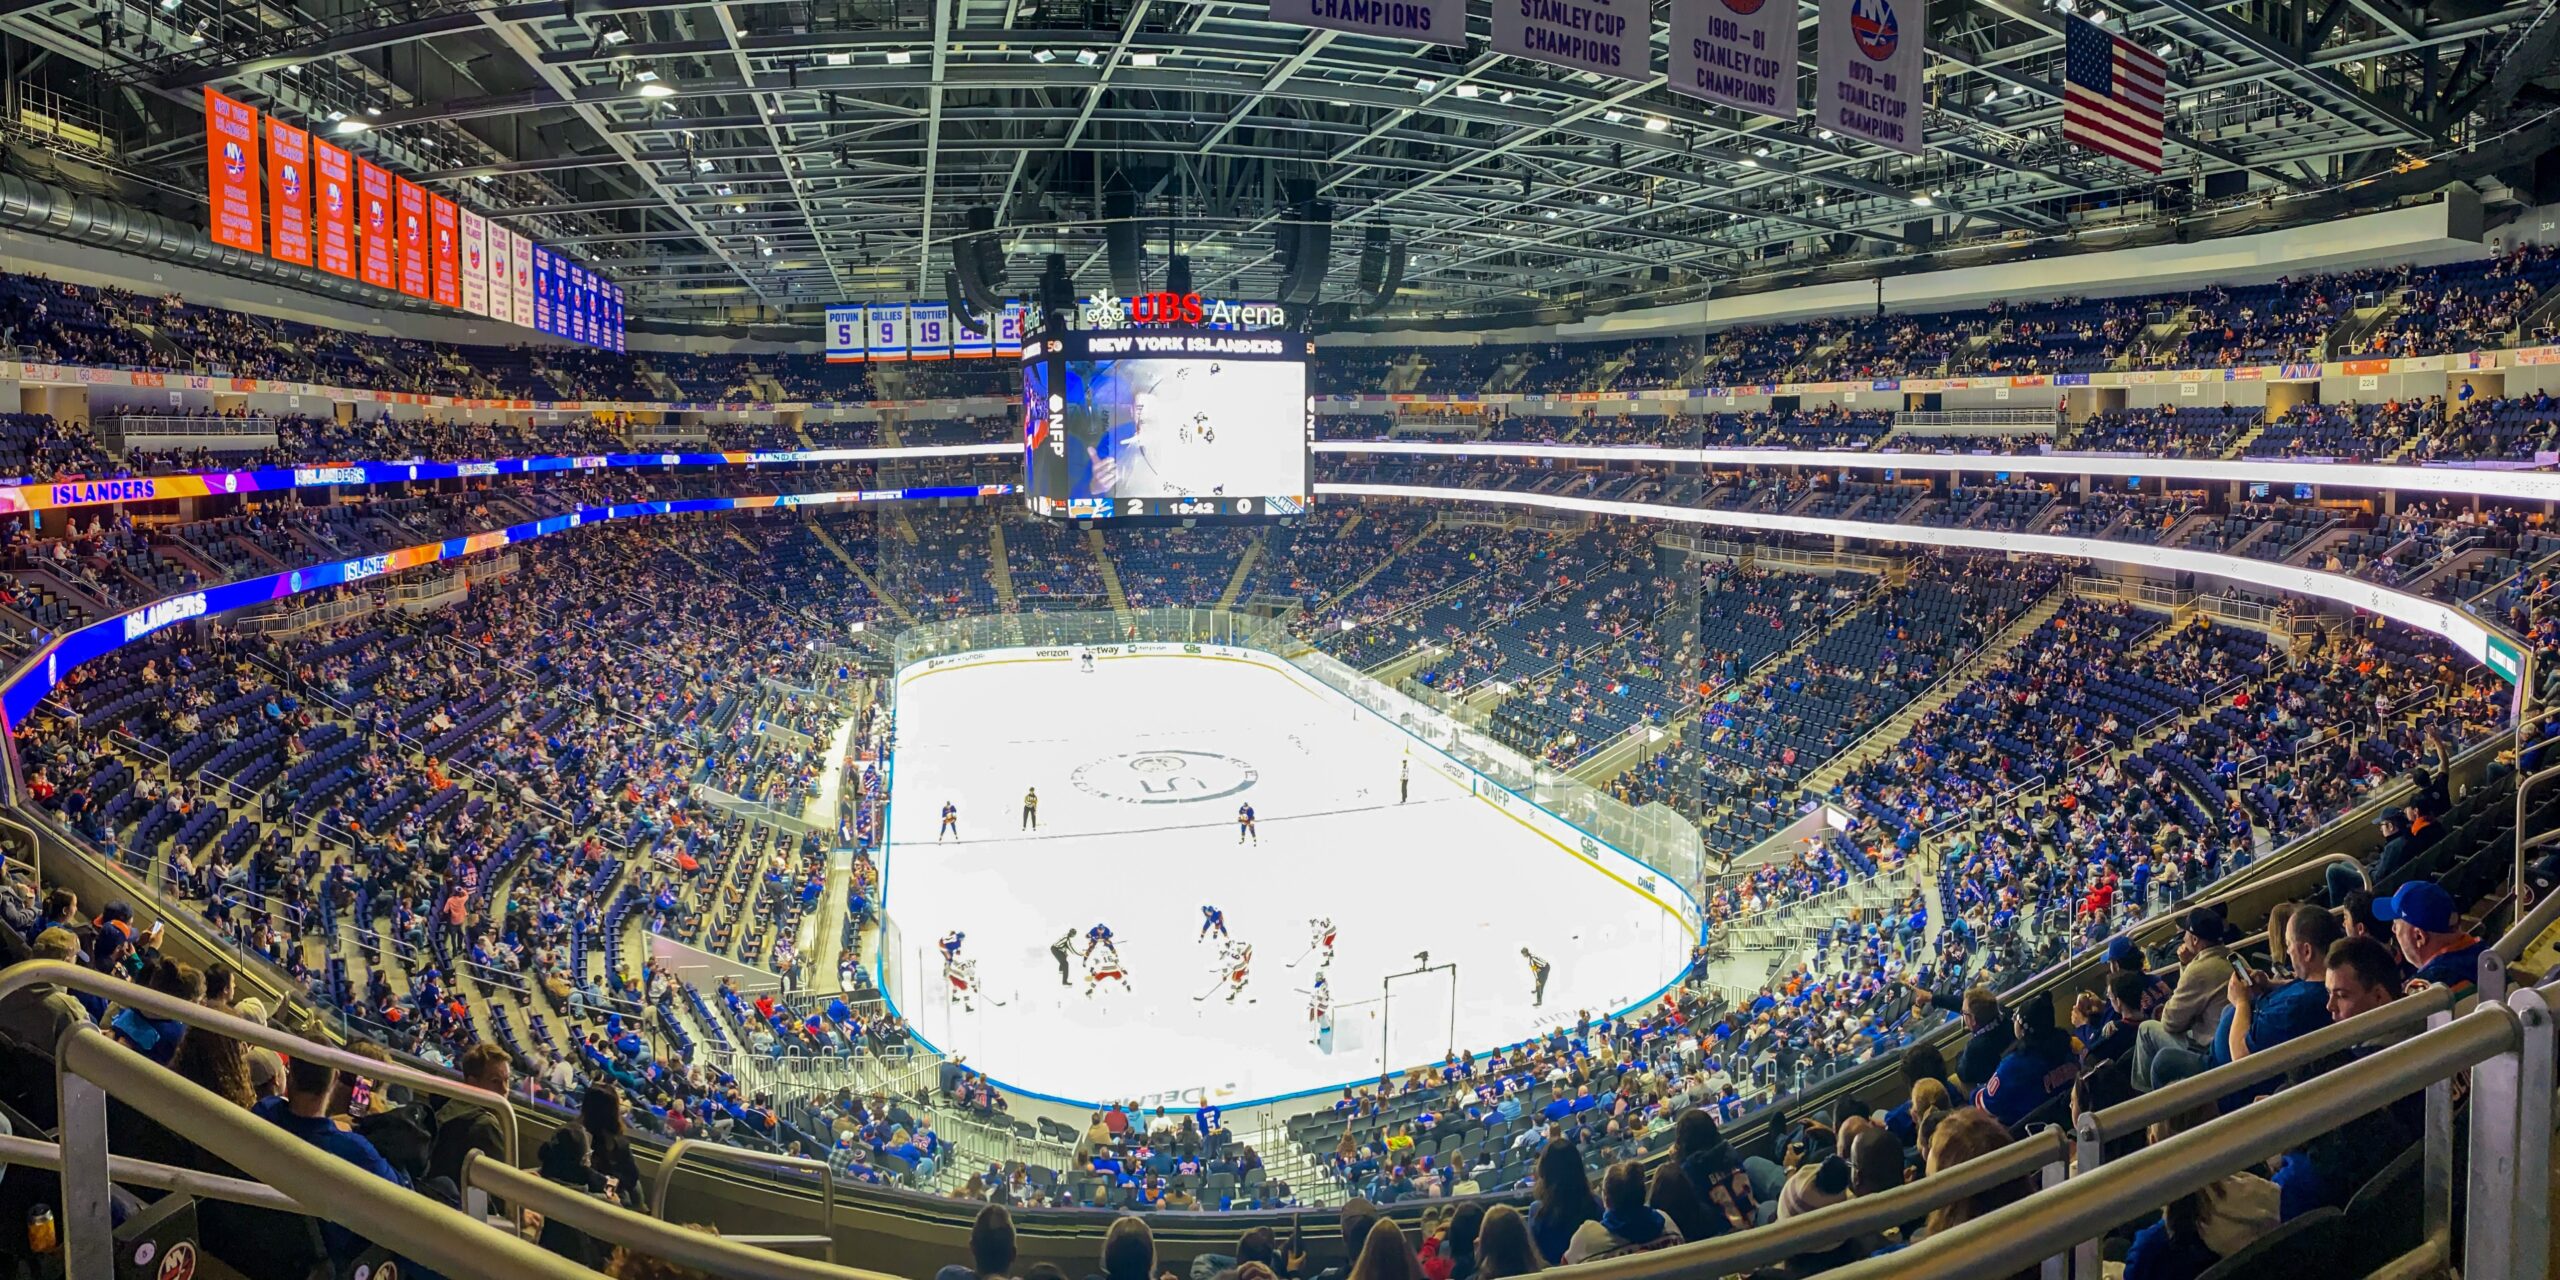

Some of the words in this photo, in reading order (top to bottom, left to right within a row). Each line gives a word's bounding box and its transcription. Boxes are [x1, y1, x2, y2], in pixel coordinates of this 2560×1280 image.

[1311, 0, 1431, 31] CHAMPIONS
[1520, 0, 1592, 31] STANLEY
[1594, 12, 1626, 37] CUP
[1525, 26, 1620, 67] CHAMPIONS
[1693, 38, 1750, 74] STANLEY
[1753, 58, 1780, 80] CUP
[1697, 67, 1775, 106] CHAMPIONS
[1838, 81, 1886, 112] STANLEY
[1886, 96, 1907, 119] CUP
[1840, 107, 1904, 143] CHAMPIONS
[829, 312, 859, 323] POTVIN
[871, 311, 902, 321] GILLIES
[912, 309, 948, 320] TROTTIER
[1132, 292, 1203, 323] UBS
[1211, 300, 1284, 326] Arena
[838, 324, 851, 345] 5
[881, 323, 894, 343] 9
[920, 321, 940, 342] 19
[1088, 337, 1132, 353] NEW
[1135, 337, 1185, 352] YORK
[1186, 338, 1283, 354] ISLANDERS
[2362, 378, 2375, 388] 224
[1050, 413, 1064, 457] NFP
[52, 480, 155, 505] ISLANDERS
[1128, 499, 1143, 514] 2
[1169, 502, 1215, 515] 19:42
[1237, 499, 1251, 514] 0
[124, 592, 207, 642] ISLANDERS
[1036, 649, 1069, 657] verizon
[1491, 784, 1510, 807] NFP
[1637, 876, 1656, 894] DIME
